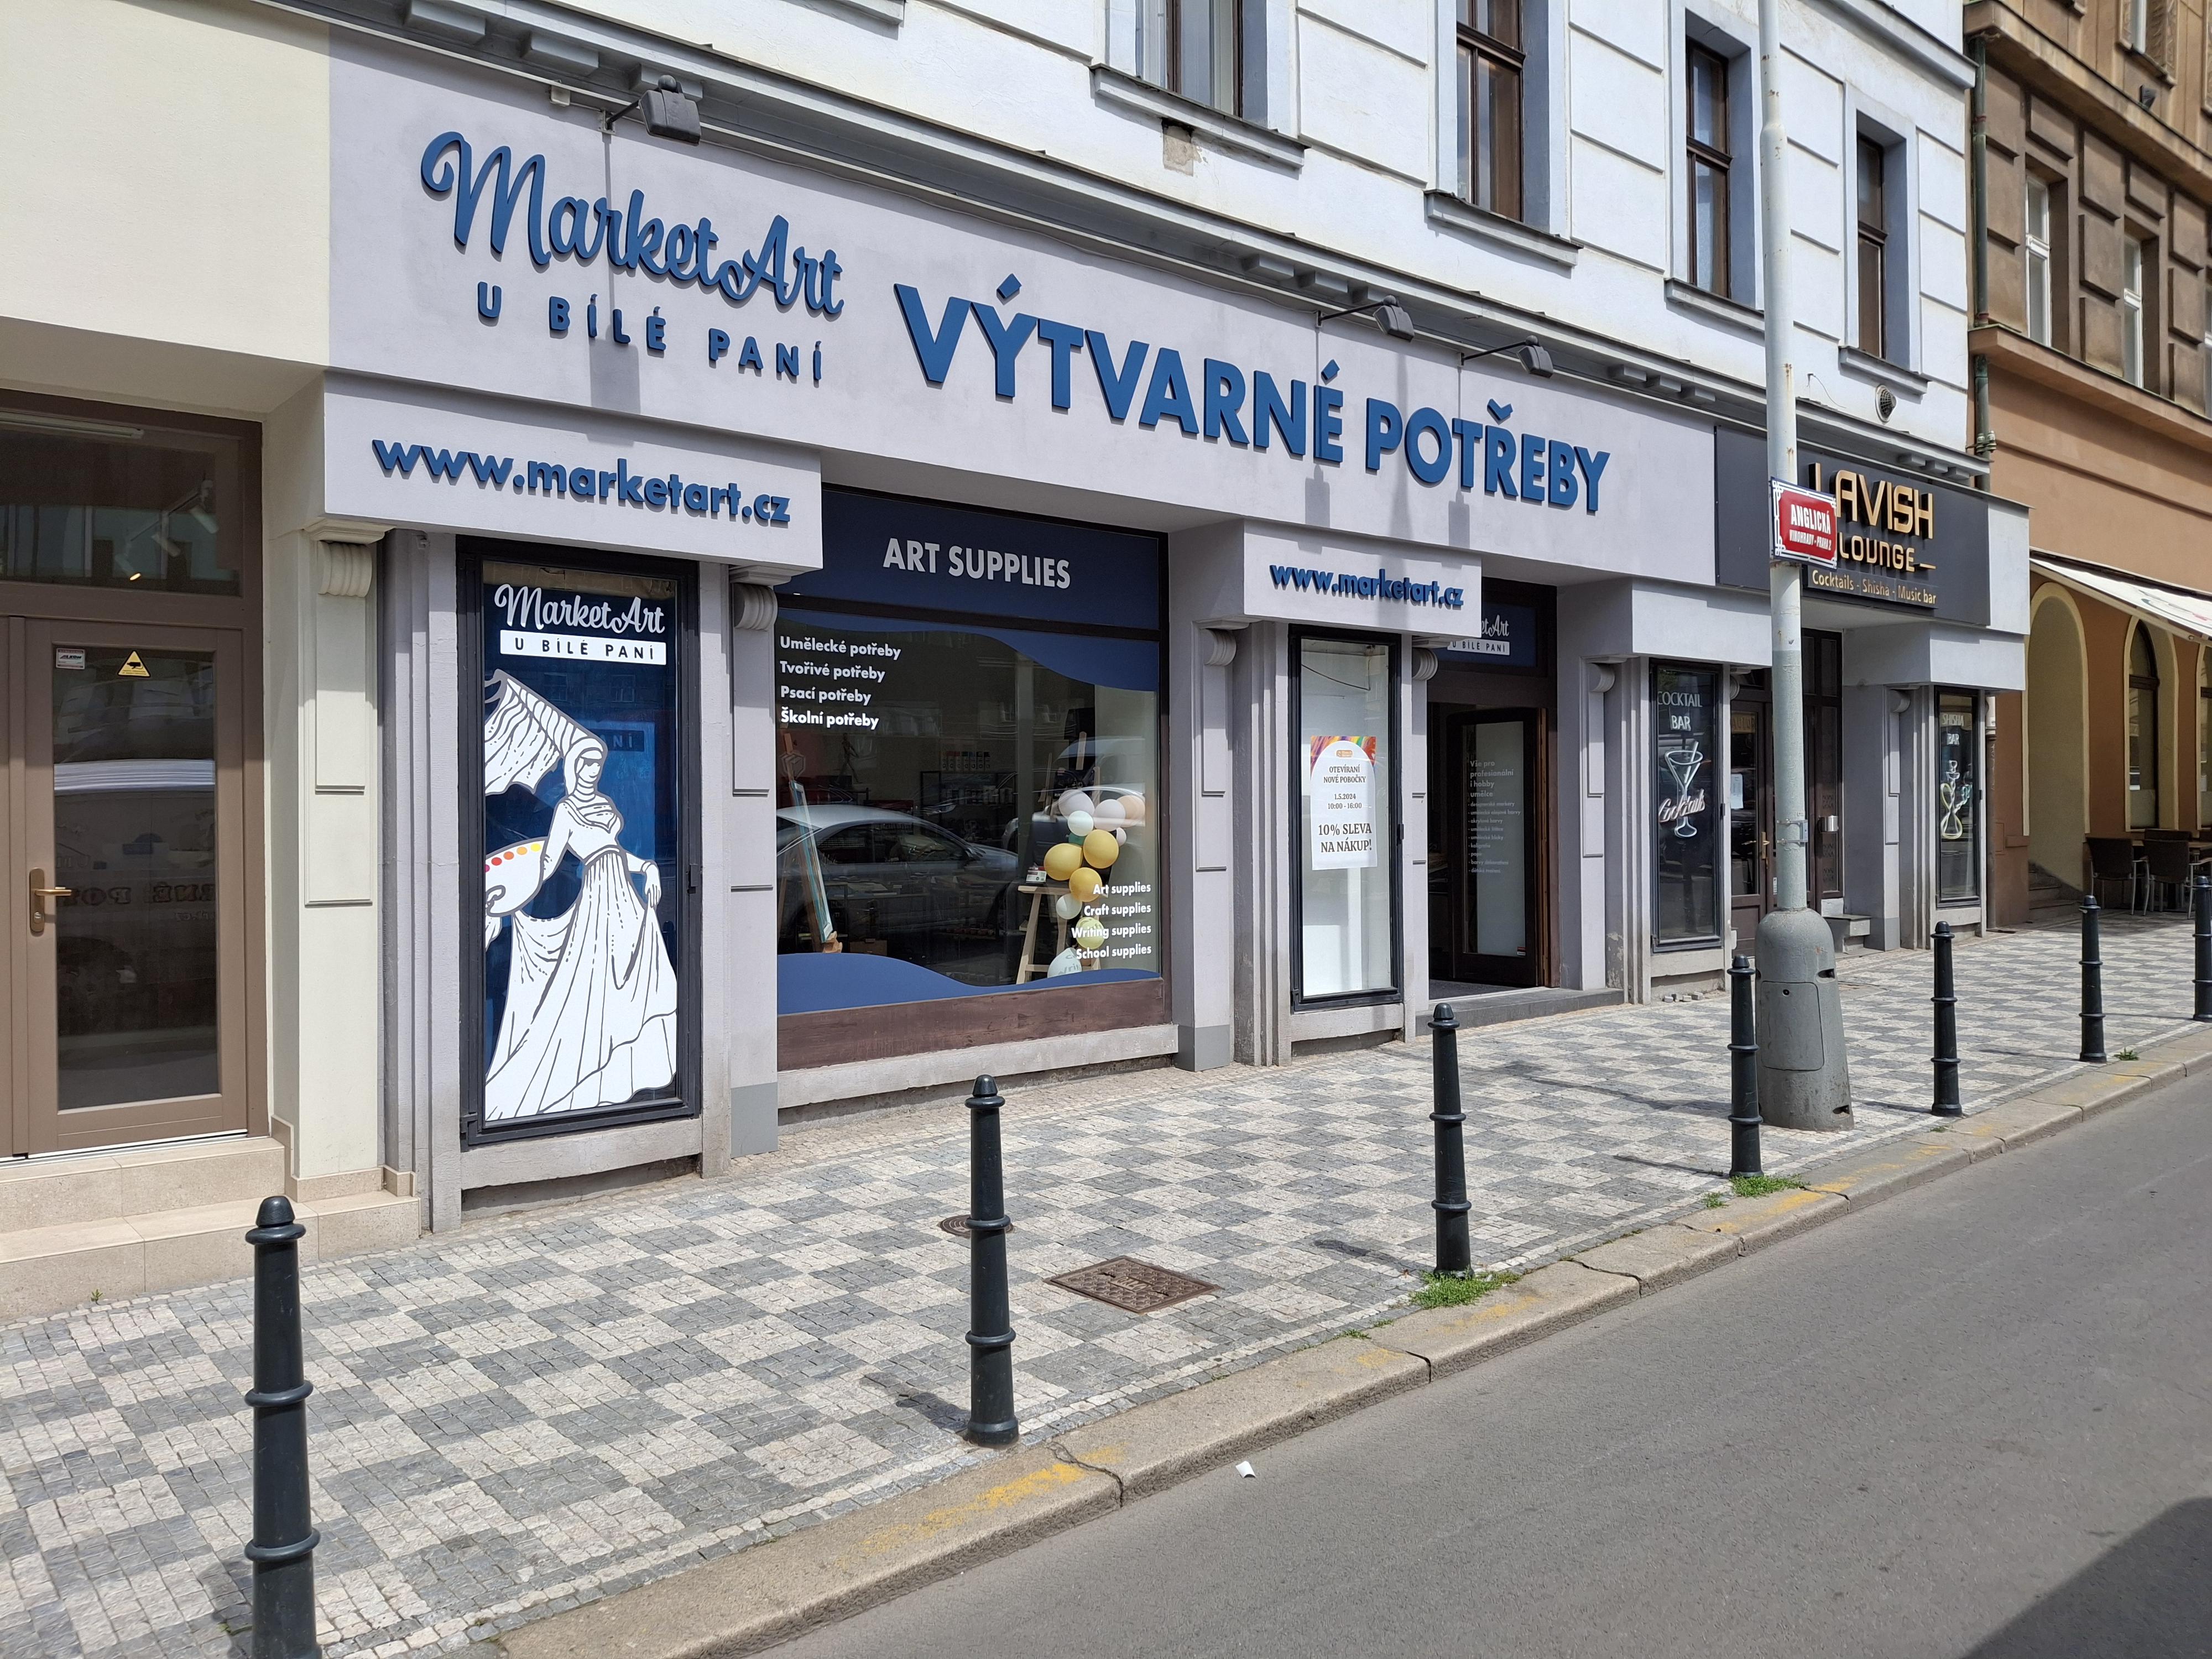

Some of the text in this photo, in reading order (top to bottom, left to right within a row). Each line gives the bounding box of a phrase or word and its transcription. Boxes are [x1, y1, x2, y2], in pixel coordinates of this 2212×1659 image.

[478, 281, 822, 381] U BÍLÉ PANÍ
[894, 273, 1611, 512] VÝTVARNÉ POTŘEBY
[371, 440, 791, 523] www.marketart.cz
[1791, 504, 1831, 535] ANGLICKÁ
[1789, 529, 1814, 546] VINOHRADY
[1817, 536, 1828, 550] PRAHA
[1828, 539, 1832, 551] 2
[1838, 532, 1915, 572] LOUNGE
[883, 538, 1071, 588] ART SUPPLIES
[1270, 565, 1464, 607] www.marketart.cz
[1812, 570, 1854, 591] Cocktails
[1863, 578, 1890, 597] Shisha
[1898, 585, 1921, 601] Music
[1923, 589, 1937, 604] bar
[515, 637, 654, 660] U BÍLÉ PANÍ
[780, 636, 901, 660] Umělecké potřeby
[780, 660, 885, 683] Tvořivé potřeby
[780, 686, 872, 706] Psací potřeby
[1657, 691, 1703, 707] COCKTAIL
[781, 706, 879, 730] Školní potřeby
[1671, 715, 1692, 731] BAR
[1942, 713, 1964, 727] SHISHA
[1947, 733, 1960, 745] BAR
[1323, 774, 1366, 783] NOVÉ POBOČKY
[1329, 764, 1360, 773] OTEVÍRANÍ
[1318, 823, 1372, 836] 10% SLEVA
[1321, 837, 1371, 853] NA NÁKUP!
[1093, 881, 1151, 896] Art supplies
[1084, 902, 1151, 917] Craft supplies
[1071, 927, 1109, 939] Writing
[1112, 923, 1151, 937] supplies
[1076, 943, 1151, 959] School supplies
